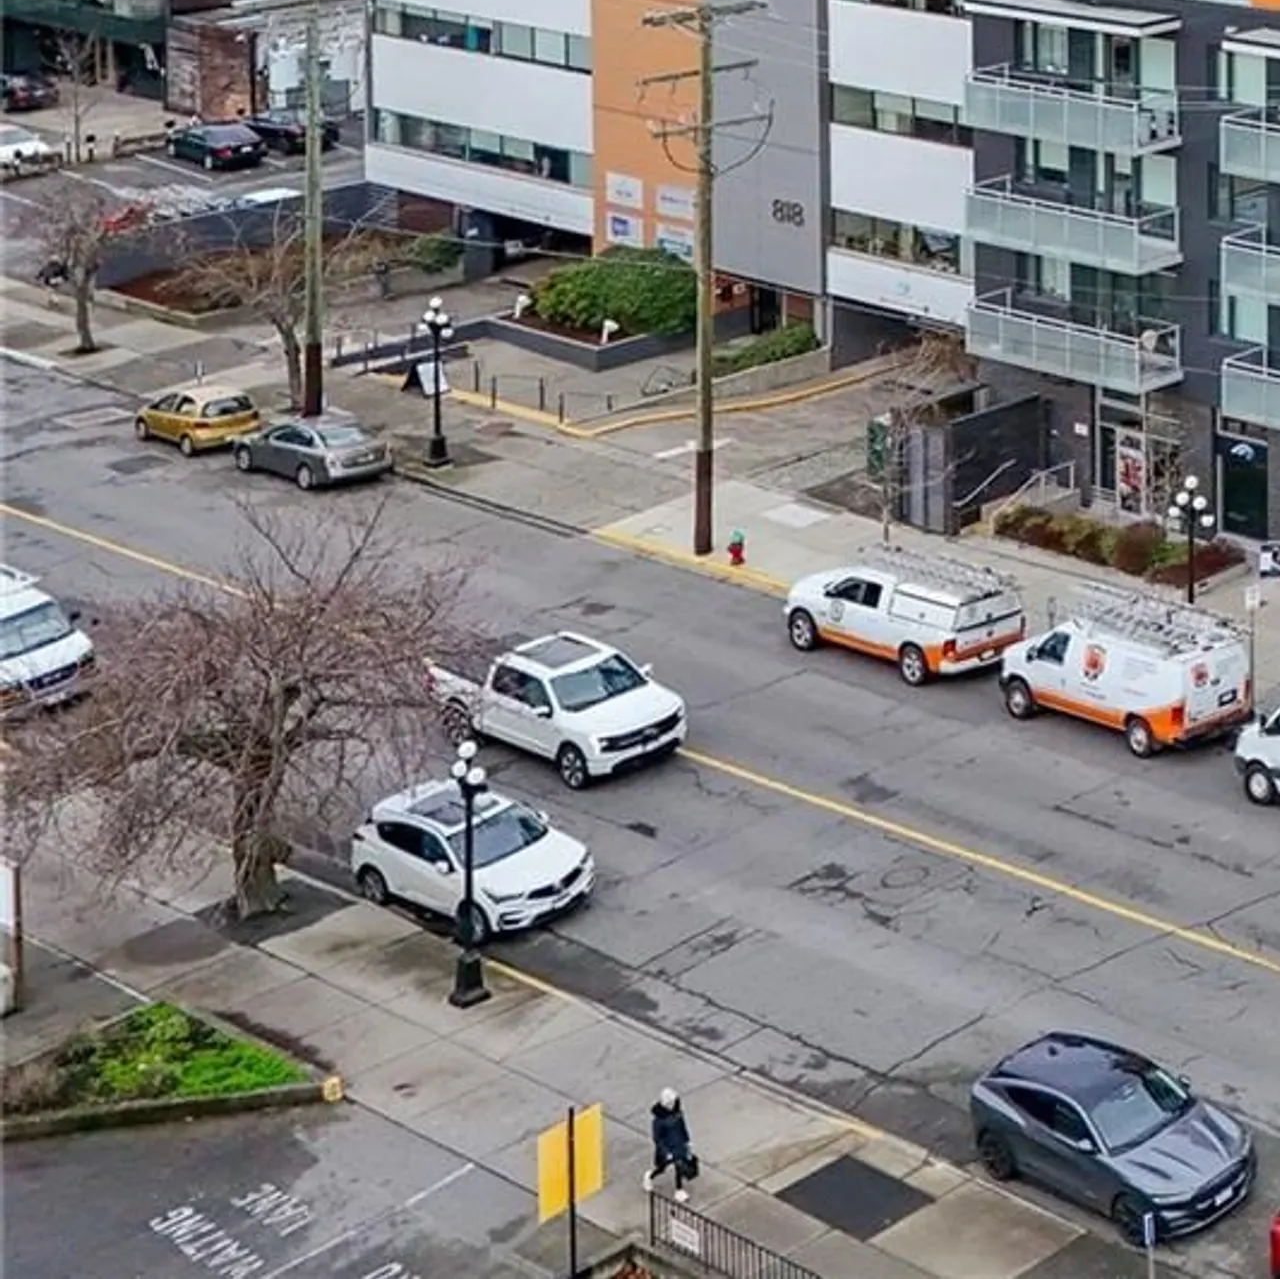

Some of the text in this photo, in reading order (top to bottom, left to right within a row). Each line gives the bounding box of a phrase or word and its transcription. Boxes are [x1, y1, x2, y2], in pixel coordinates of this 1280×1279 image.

[771, 198, 805, 227] 818
[230, 1182, 311, 1238] LANE
[148, 1205, 265, 1279] WAITING
